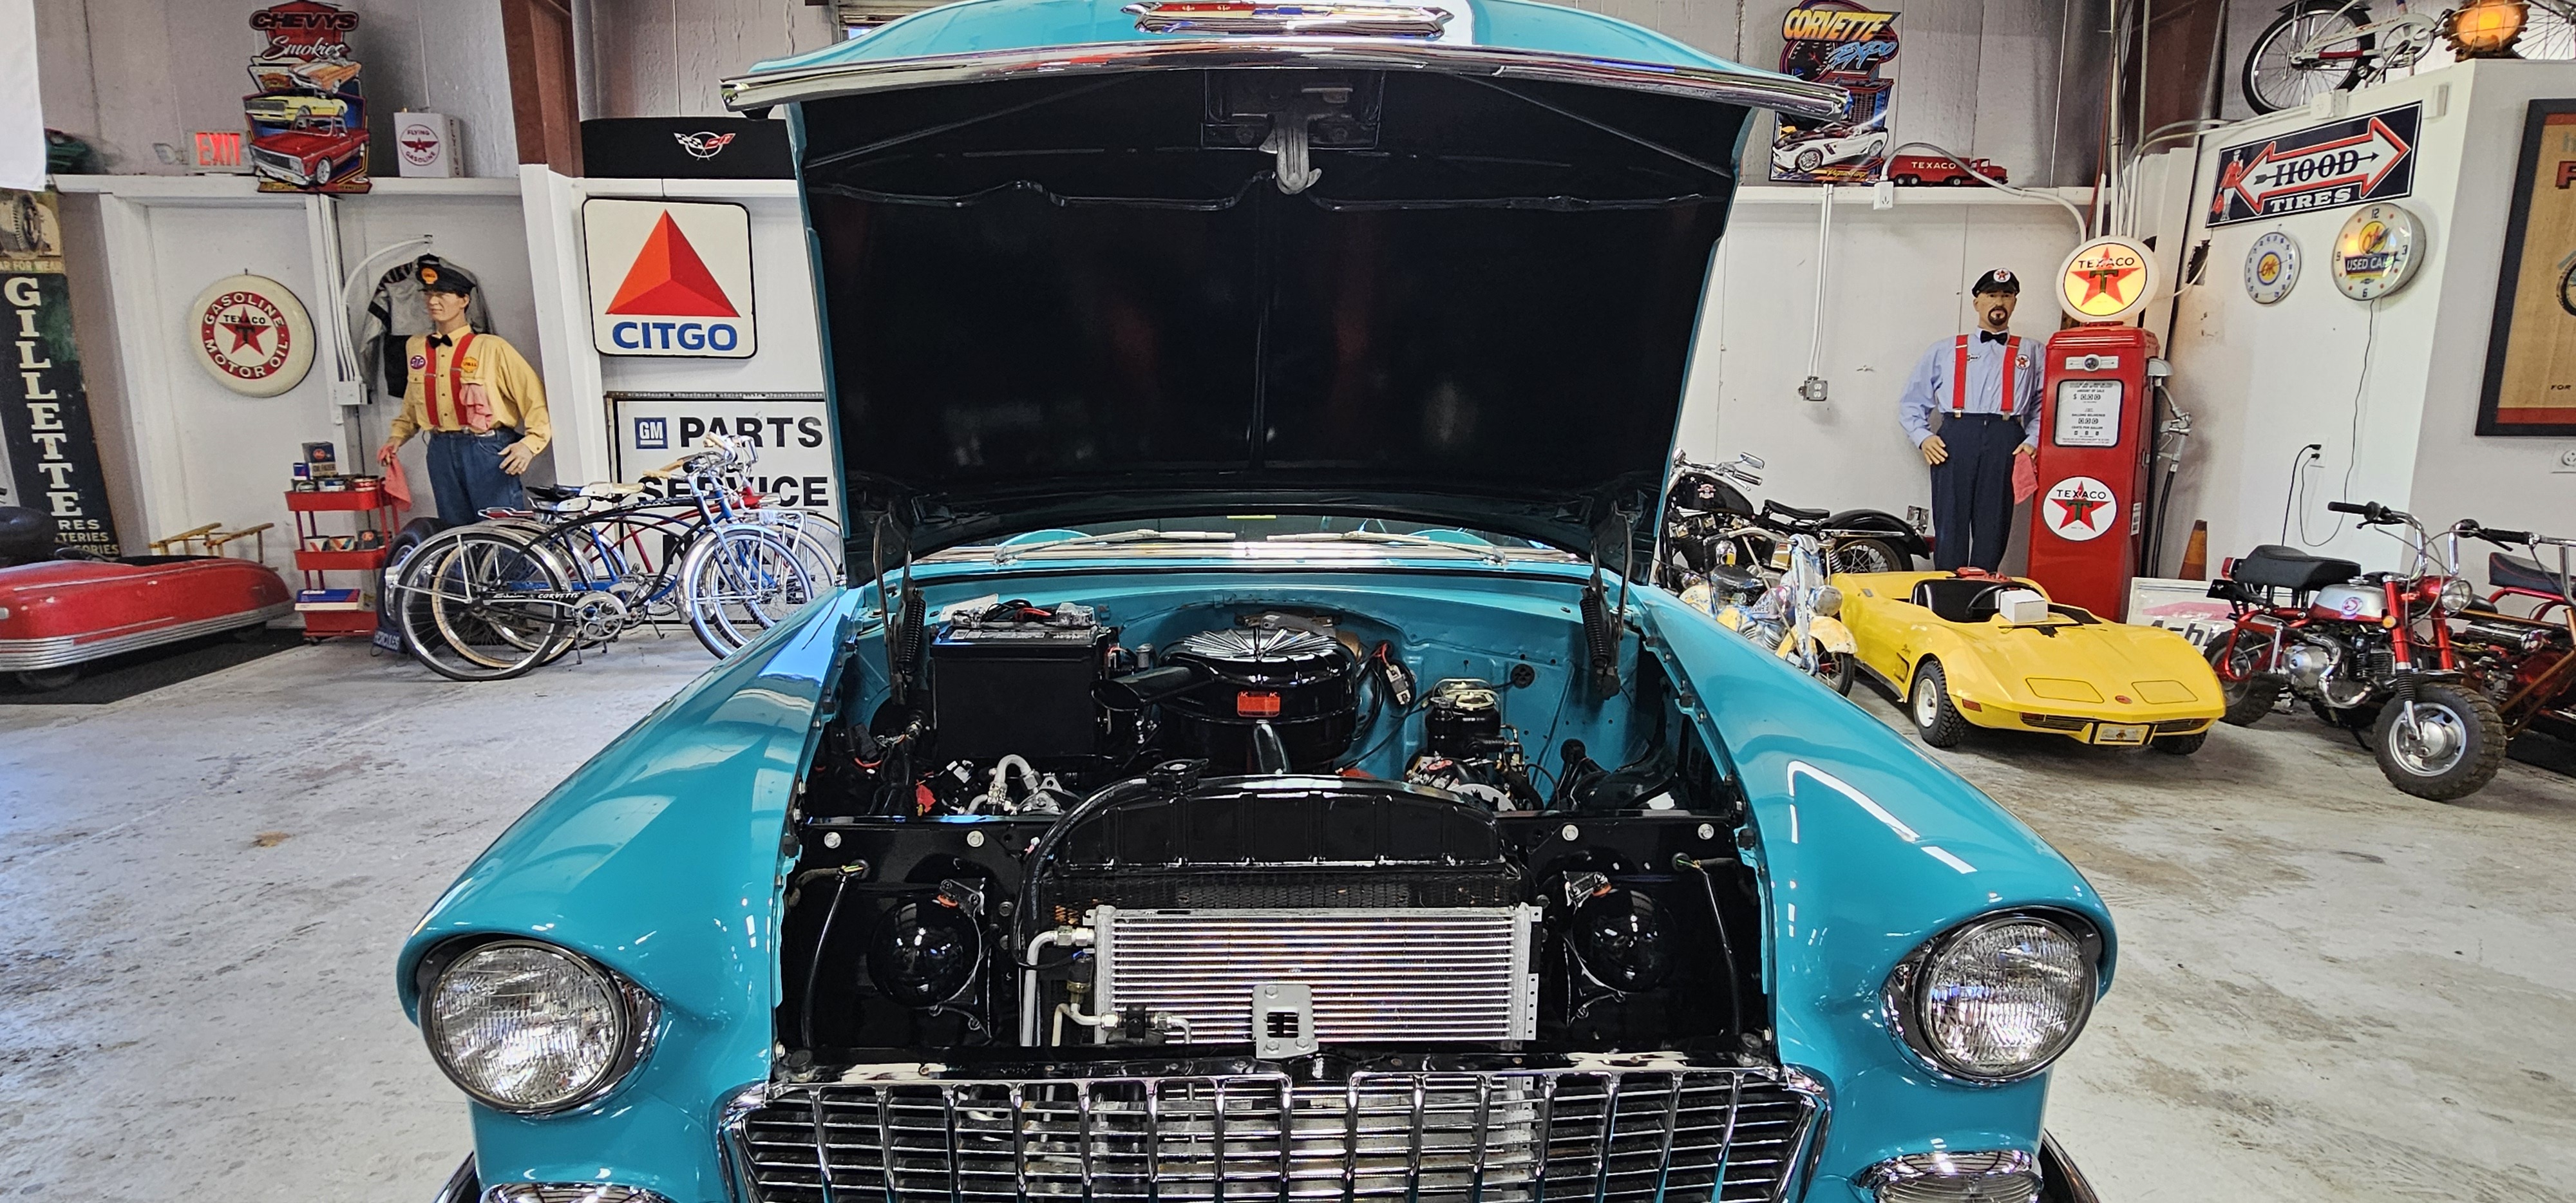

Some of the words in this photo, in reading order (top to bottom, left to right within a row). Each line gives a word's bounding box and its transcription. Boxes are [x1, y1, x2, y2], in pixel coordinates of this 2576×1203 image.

[251, 11, 357, 30] CHEVYS
[1783, 8, 1893, 41] CORVETTE
[262, 35, 346, 59] Smokies
[196, 133, 241, 166] EXIT
[406, 151, 435, 162] GASOLINE
[1911, 161, 1956, 170] TEXACO
[2273, 149, 2359, 187] HOOD
[2269, 188, 2352, 213] TIRES
[2371, 208, 2380, 219] 12
[2401, 245, 2408, 255] 3
[2078, 257, 2135, 269] TEXACO
[2347, 258, 2368, 270] USED
[2371, 256, 2390, 269] CA
[2362, 289, 2368, 298] 6
[204, 292, 284, 327] GASOLINE
[223, 314, 266, 324] TEXACO
[612, 321, 738, 351] CITGO
[204, 339, 266, 377] MOTOR
[270, 341, 288, 368] OIL
[5, 277, 83, 516] GILLETTE
[639, 421, 663, 439] GM
[679, 417, 823, 448] PARTS
[2056, 489, 2107, 499] TEXACO
